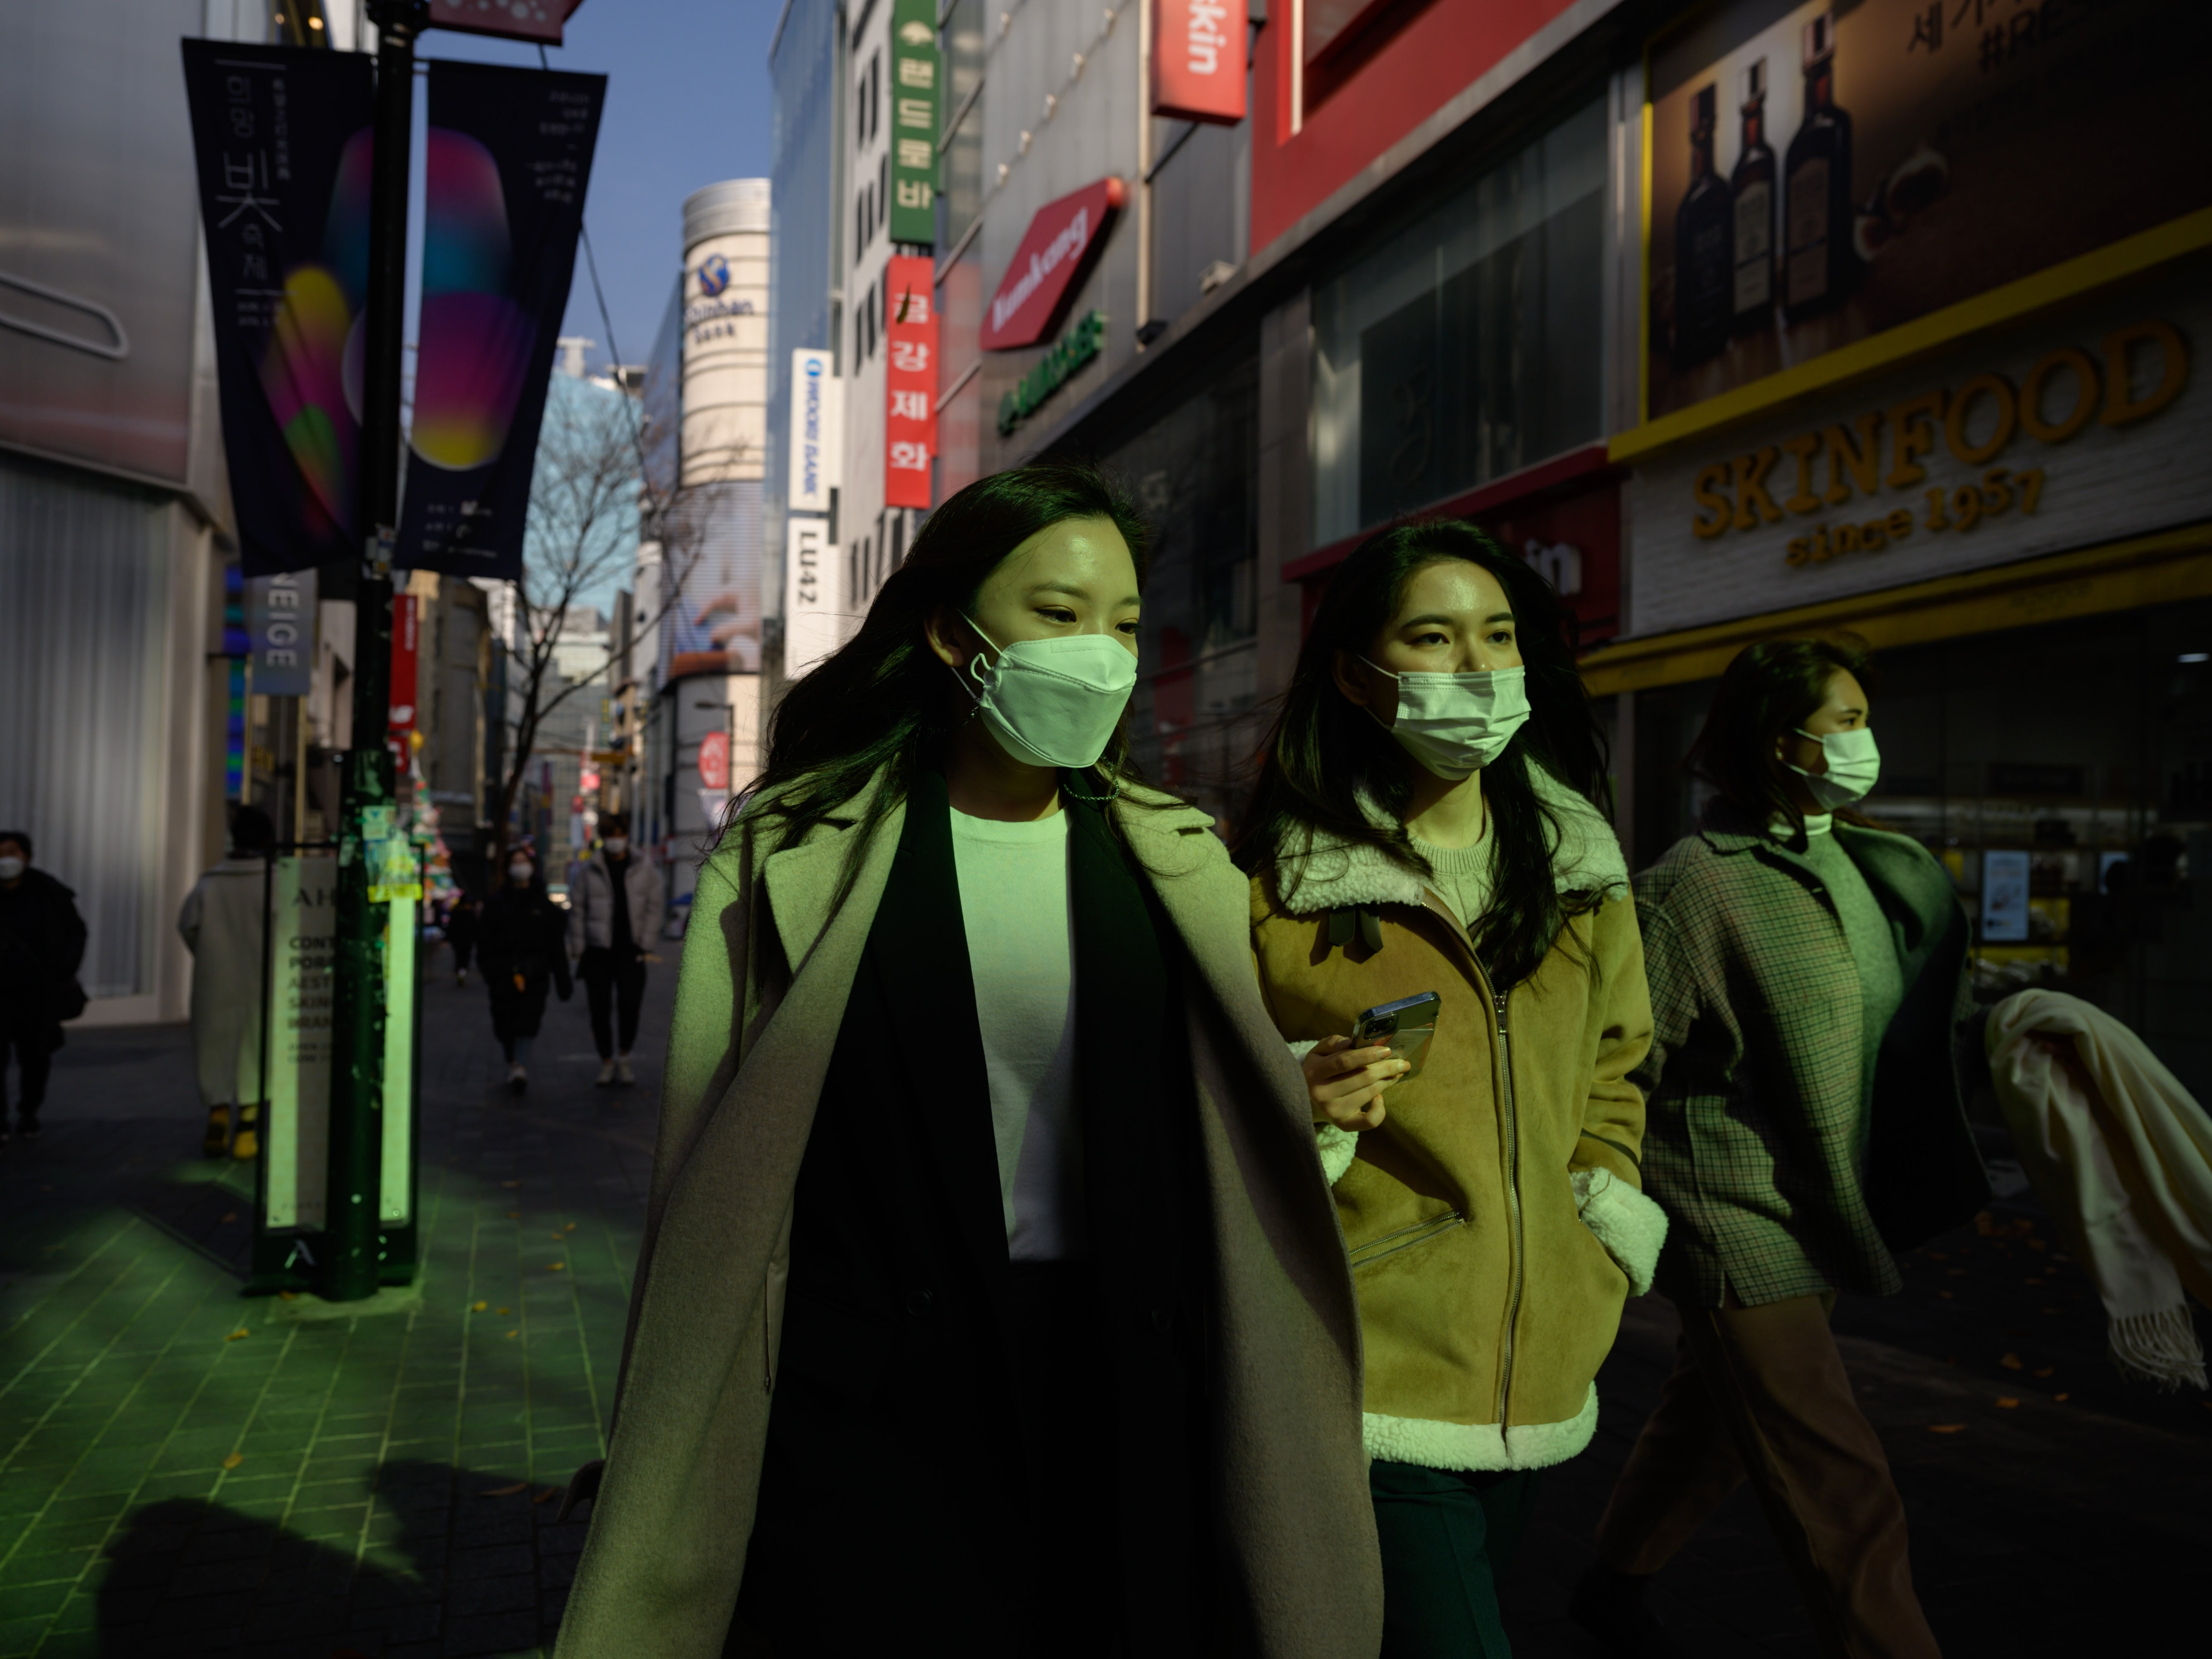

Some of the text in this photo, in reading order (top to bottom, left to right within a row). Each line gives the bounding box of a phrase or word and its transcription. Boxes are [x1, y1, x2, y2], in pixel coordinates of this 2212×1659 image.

[1187, 0, 1228, 75] kin
[889, 292, 931, 472] 금강제화
[1693, 318, 2191, 539] SKINFOOD
[1786, 468, 2044, 566] since 1957
